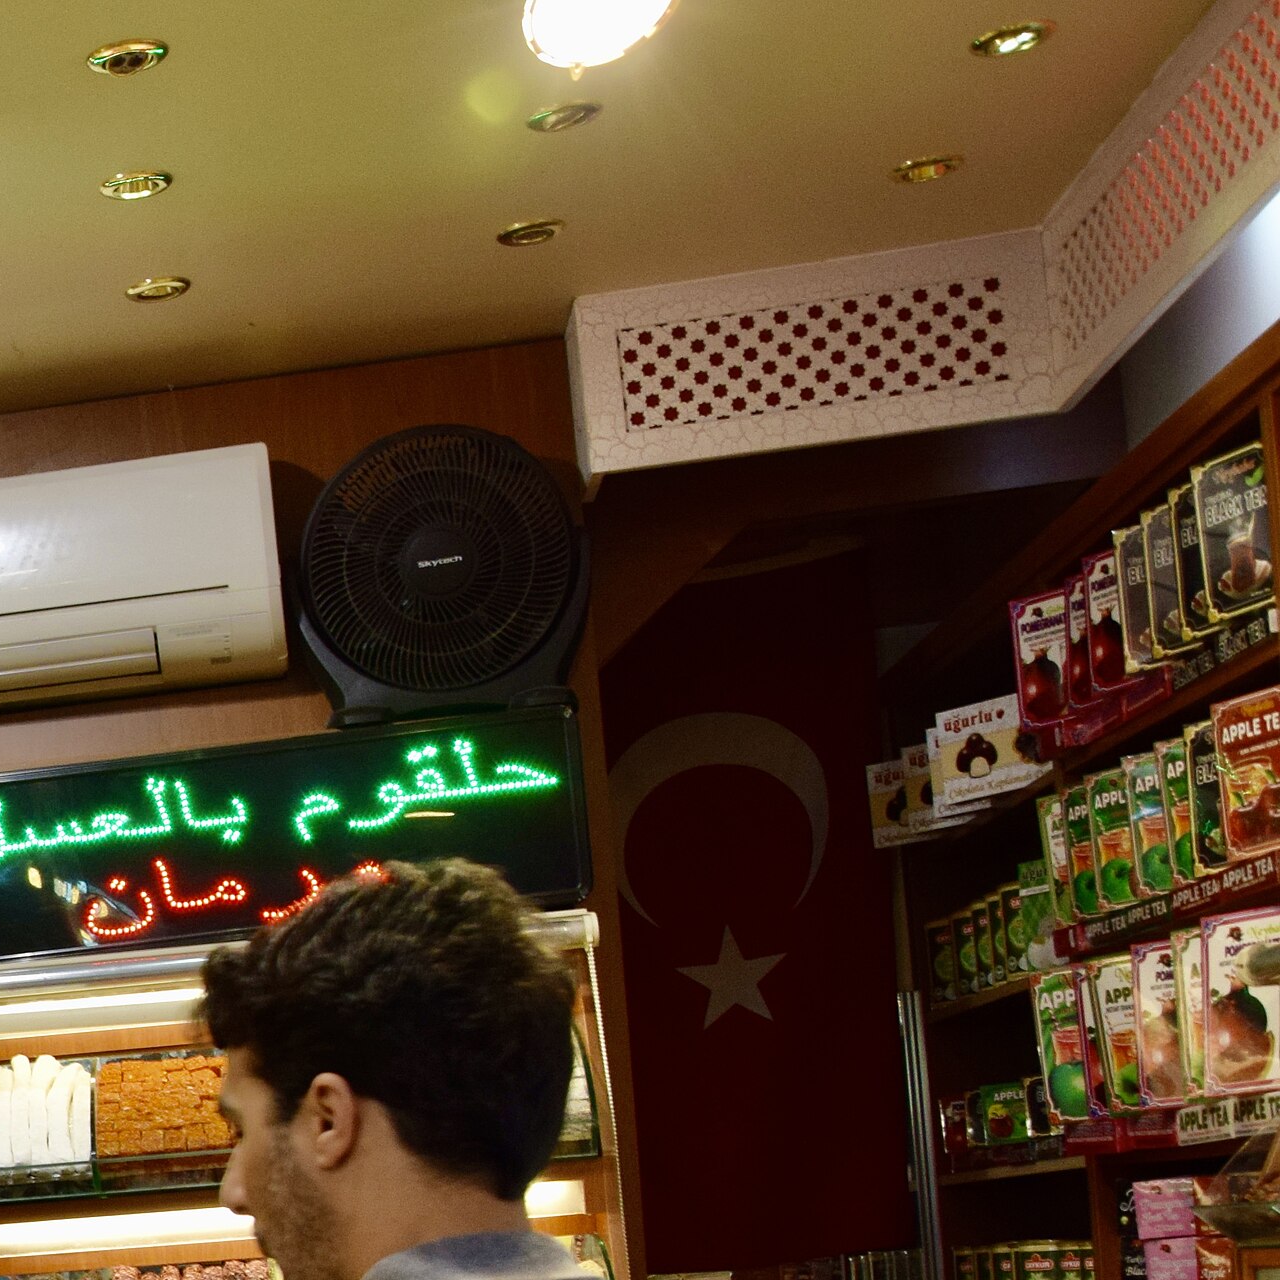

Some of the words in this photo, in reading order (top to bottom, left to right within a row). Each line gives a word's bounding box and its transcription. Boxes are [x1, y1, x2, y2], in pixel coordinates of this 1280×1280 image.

[1205, 494, 1243, 528] BLACK
[418, 555, 462, 568] Skytech
[1222, 721, 1261, 745] APPLE
[1263, 712, 1280, 732] TE
[1196, 763, 1218, 785] BLA
[1095, 791, 1126, 809] APPL
[1068, 804, 1089, 822] APP
[1222, 867, 1254, 890] APPLE
[1255, 857, 1273, 877] TEA
[1172, 885, 1202, 907] APPLE
[1040, 988, 1076, 1010] APP
[1105, 986, 1132, 1004] APP
[1179, 1106, 1209, 1130] APPLE
[1209, 1100, 1229, 1126] TEA
[1234, 1099, 1266, 1123] APPLE
